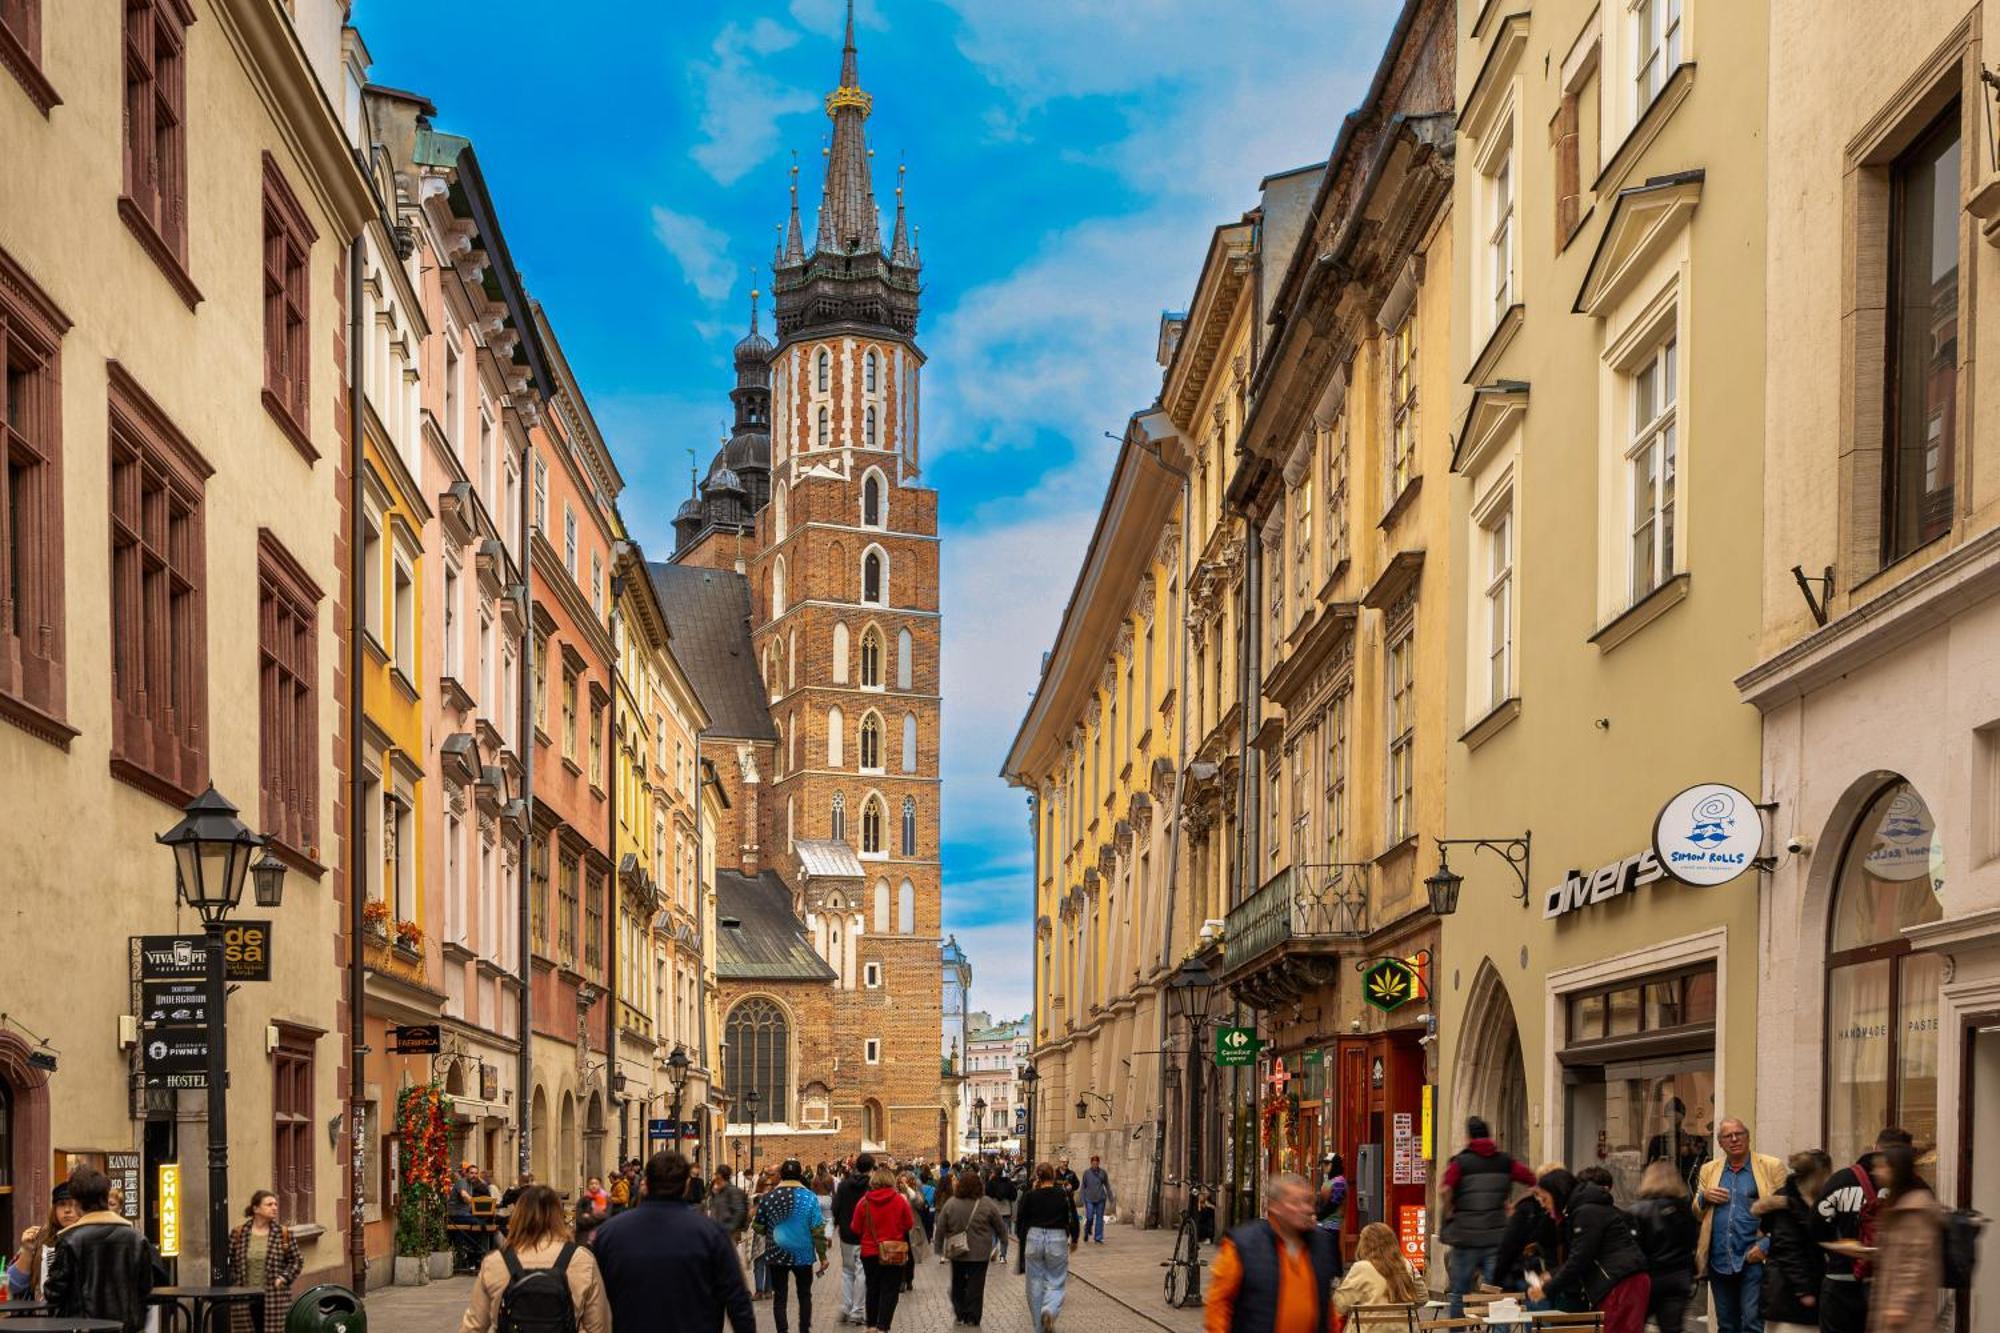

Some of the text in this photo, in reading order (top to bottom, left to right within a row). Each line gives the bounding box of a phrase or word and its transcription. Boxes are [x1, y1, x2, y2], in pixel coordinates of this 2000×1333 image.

[1671, 851, 1744, 864] SIMON ROLLS
[1544, 848, 1669, 920] divers
[225, 927, 263, 946] de
[144, 951, 174, 964] VIVA
[225, 946, 262, 962] sa
[169, 1048, 199, 1056] PIWNE
[168, 1075, 209, 1087] HOSTEL
[163, 1170, 176, 1251] CHANGE
